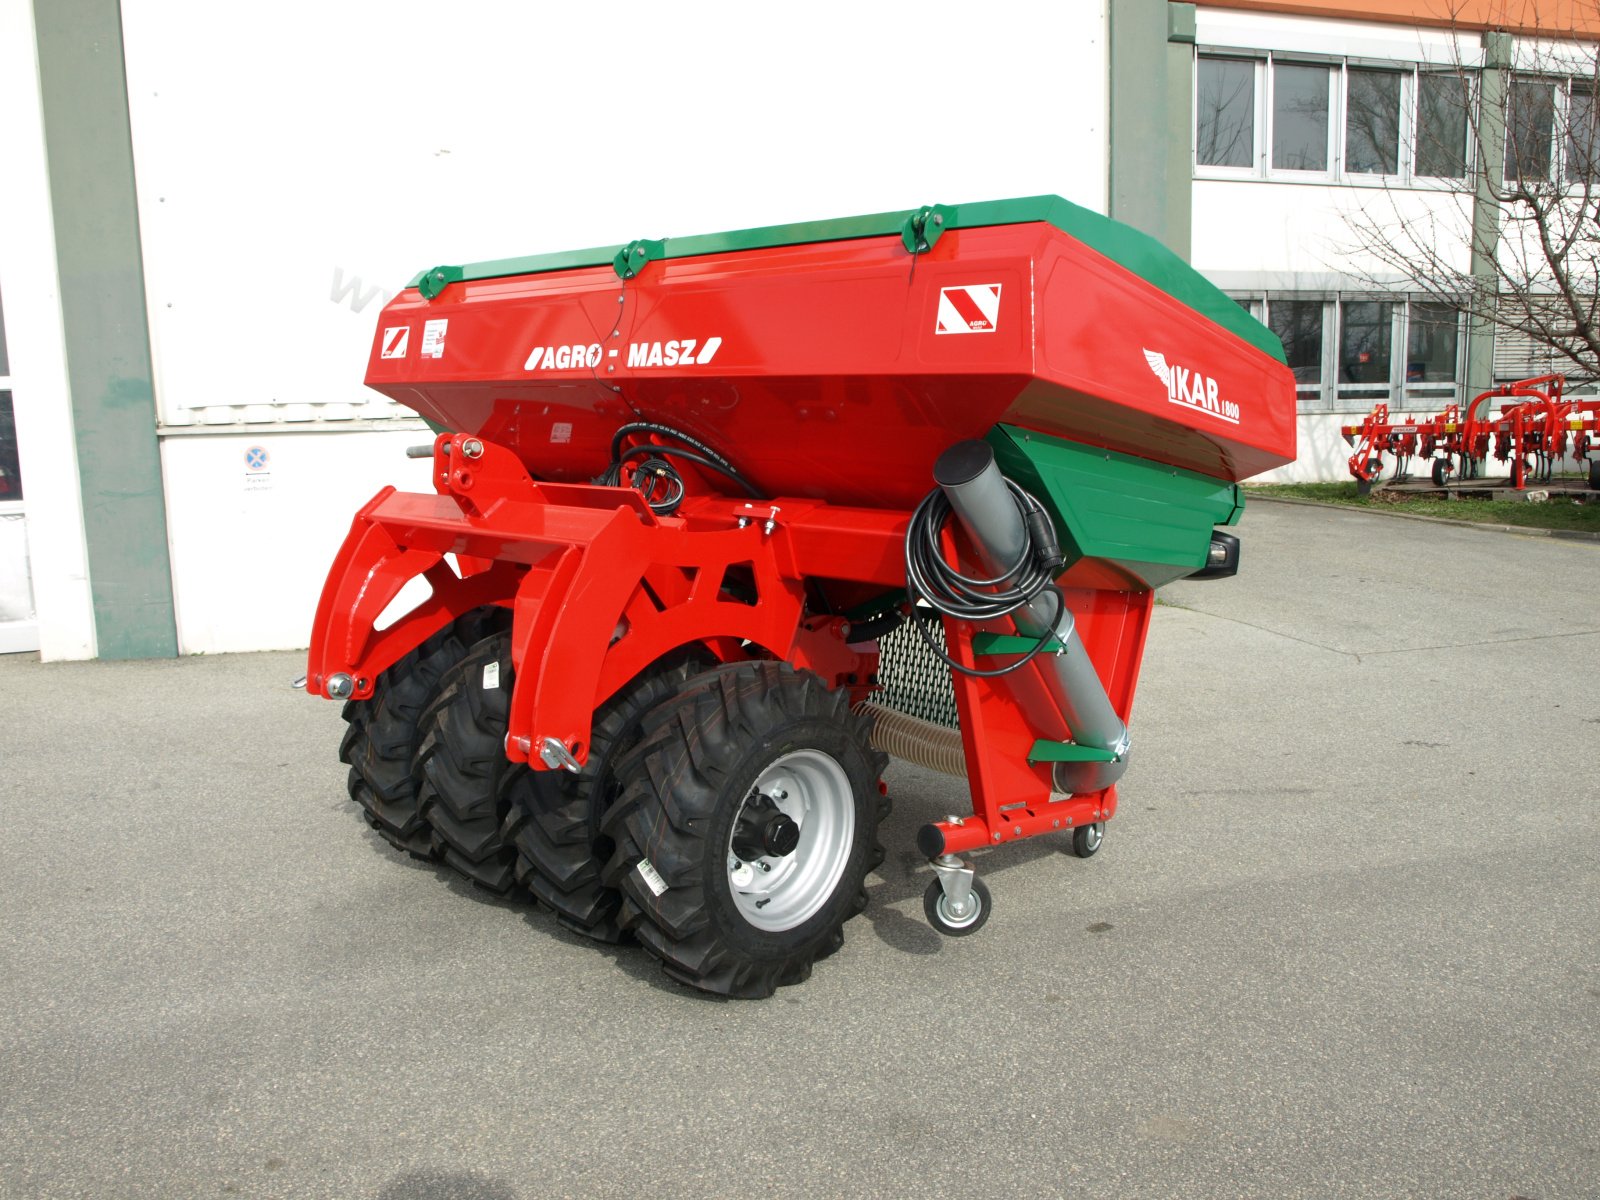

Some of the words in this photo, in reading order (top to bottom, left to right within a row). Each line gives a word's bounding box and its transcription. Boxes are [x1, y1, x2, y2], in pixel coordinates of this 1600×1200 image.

[540, 343, 603, 370] AGRO
[627, 339, 697, 368] MASZ
[1169, 364, 1221, 413] IKAR
[1221, 400, 1240, 420] 1800
